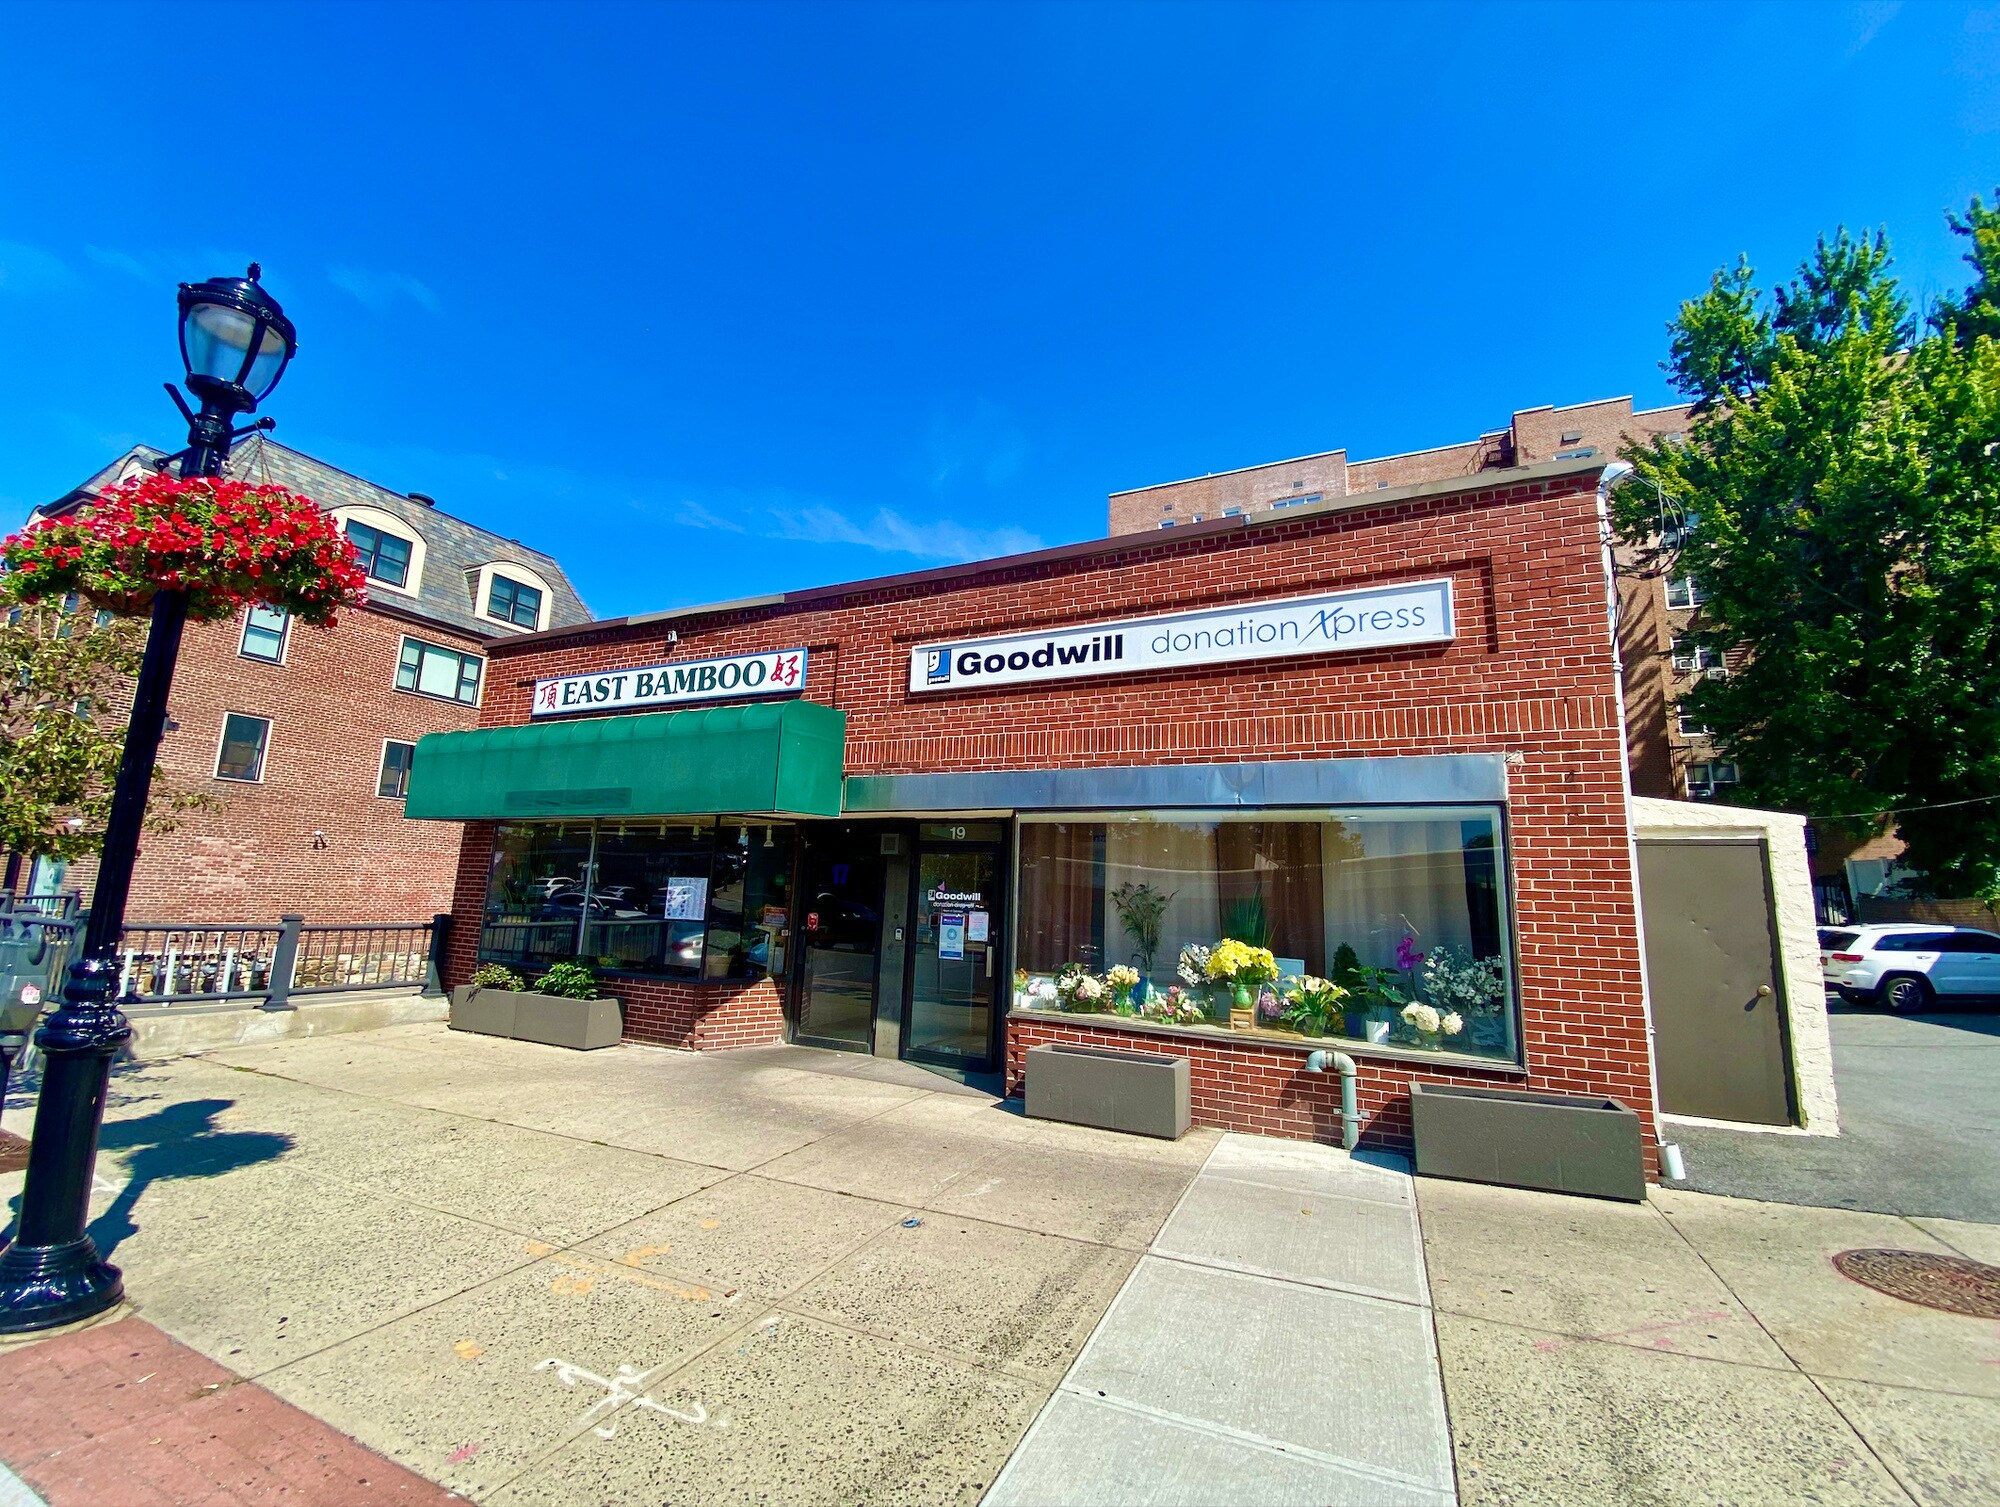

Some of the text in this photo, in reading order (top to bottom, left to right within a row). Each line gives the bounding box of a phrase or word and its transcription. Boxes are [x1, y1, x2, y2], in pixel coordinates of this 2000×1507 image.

[957, 606, 1426, 676] Goodwill donation Xpress
[539, 654, 800, 709] 頂 EAST BAMBOO 好
[949, 826, 966, 840] 19
[935, 891, 981, 901] Goodwill
